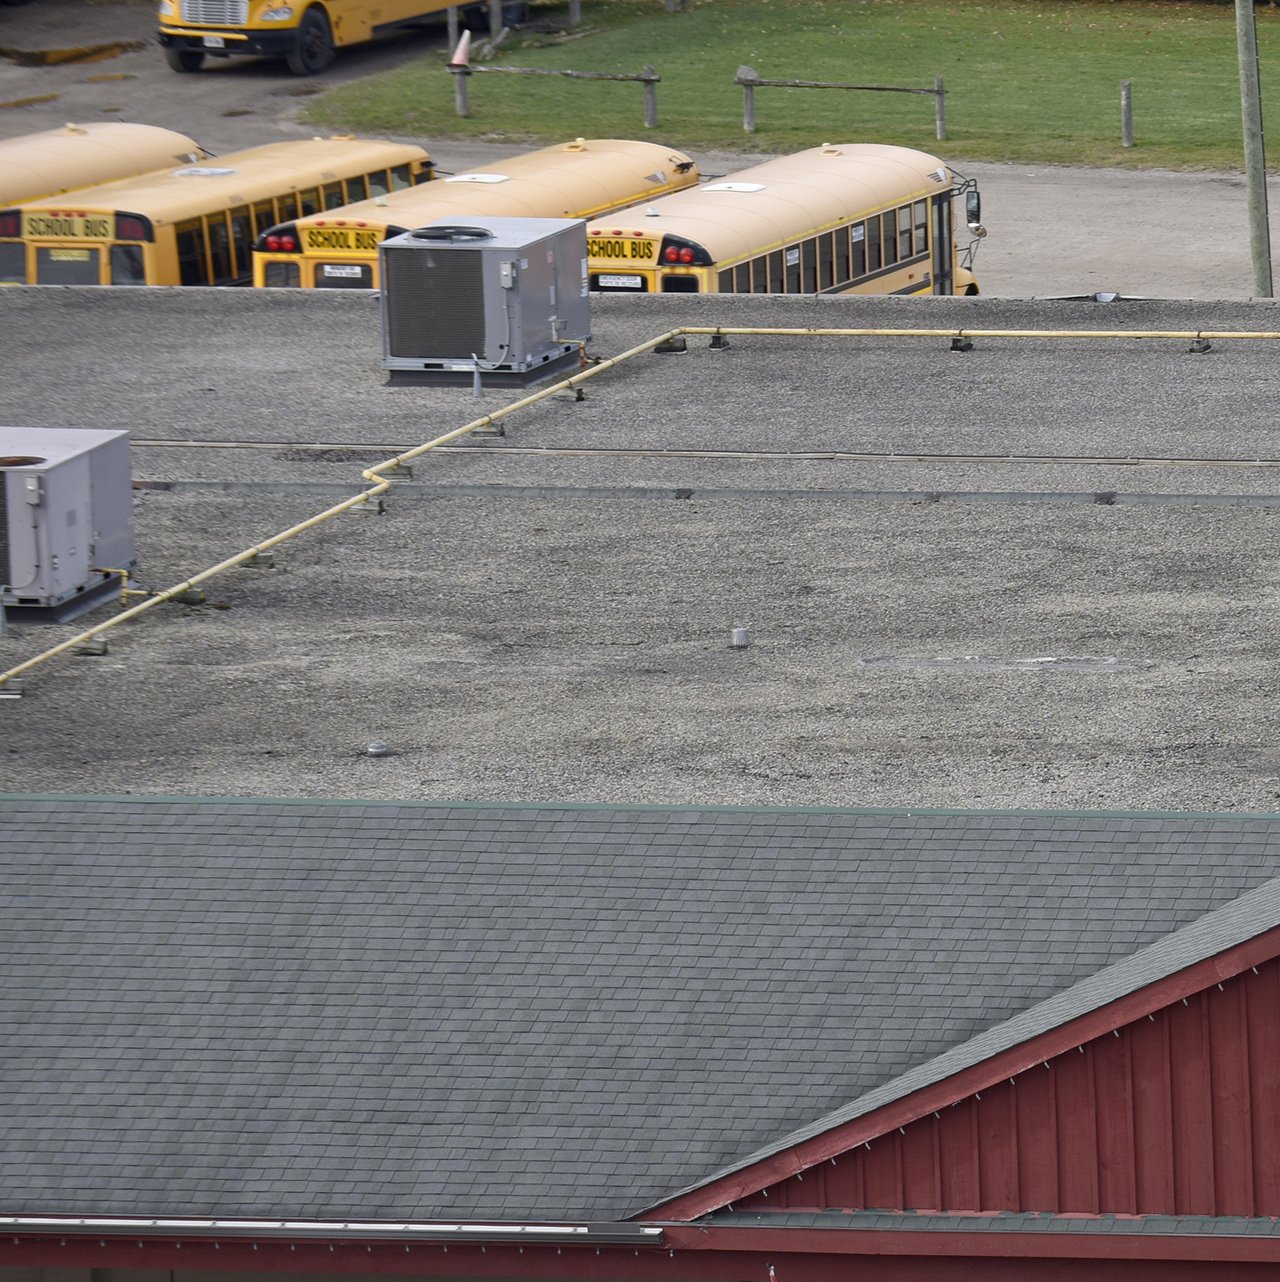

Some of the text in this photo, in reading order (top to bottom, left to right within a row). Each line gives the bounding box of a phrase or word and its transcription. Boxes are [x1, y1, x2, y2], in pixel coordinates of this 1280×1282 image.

[28, 217, 110, 238] SCHOOL BUS
[308, 230, 378, 250] SCHOOL BUS
[586, 240, 653, 259] SCHOOL BUS
